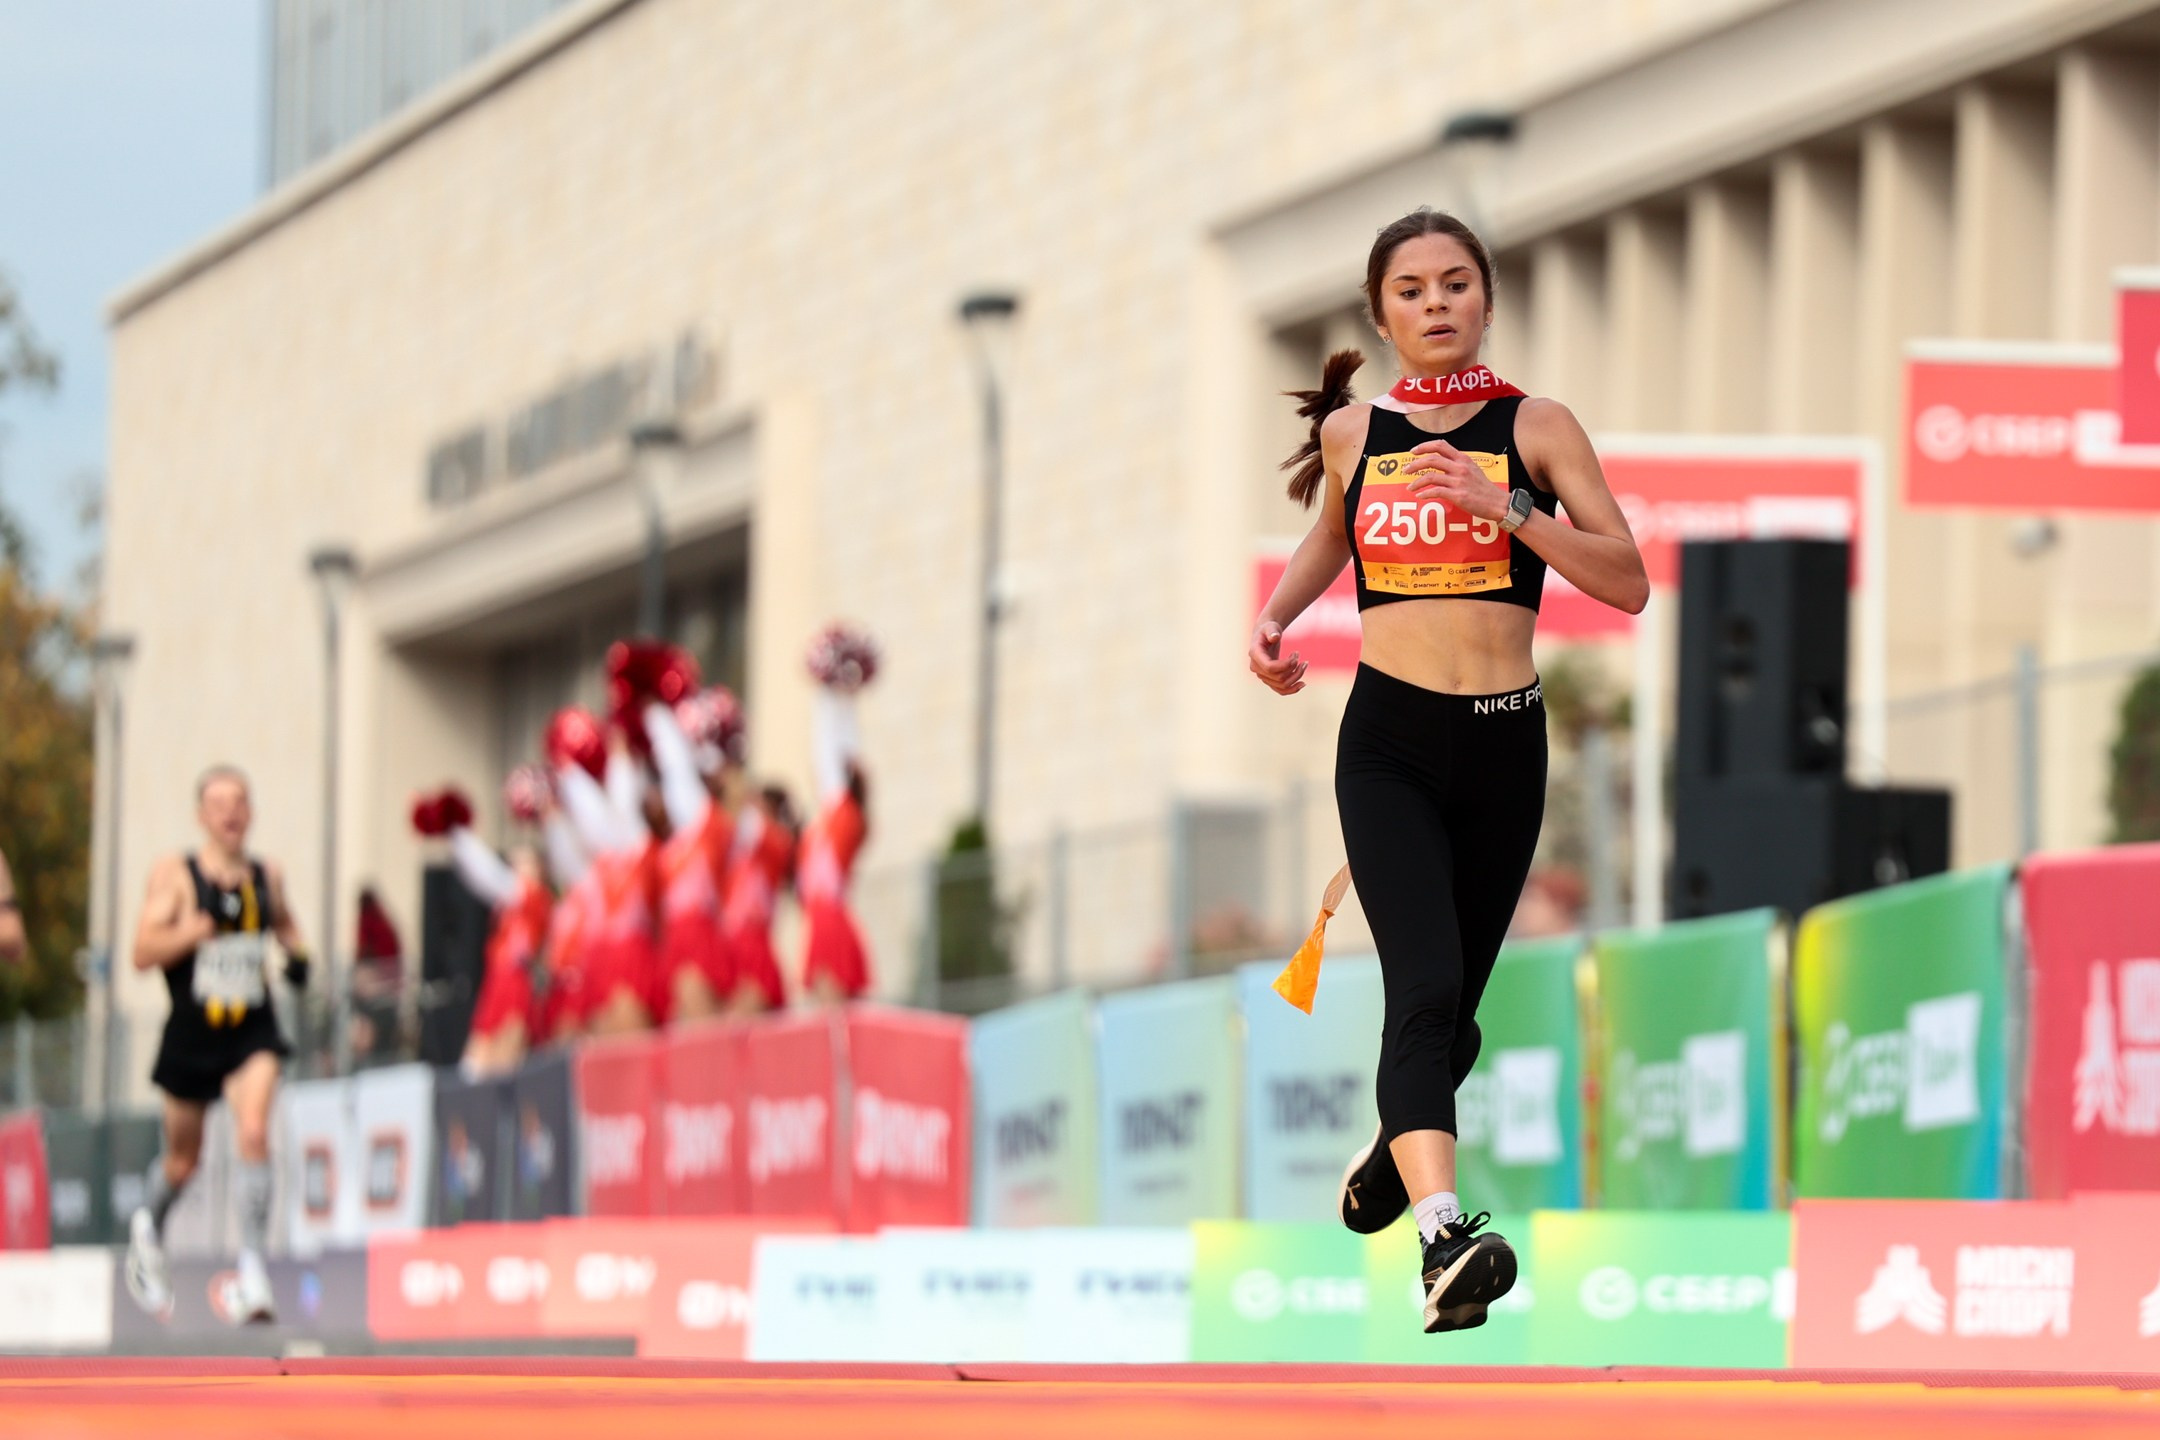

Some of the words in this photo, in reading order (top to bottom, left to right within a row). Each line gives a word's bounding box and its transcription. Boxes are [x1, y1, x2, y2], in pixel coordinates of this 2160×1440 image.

[1364, 502, 1499, 545] 250-5
[1474, 694, 1521, 715] NIKE
[1643, 1275, 1770, 1313] СБЕР
